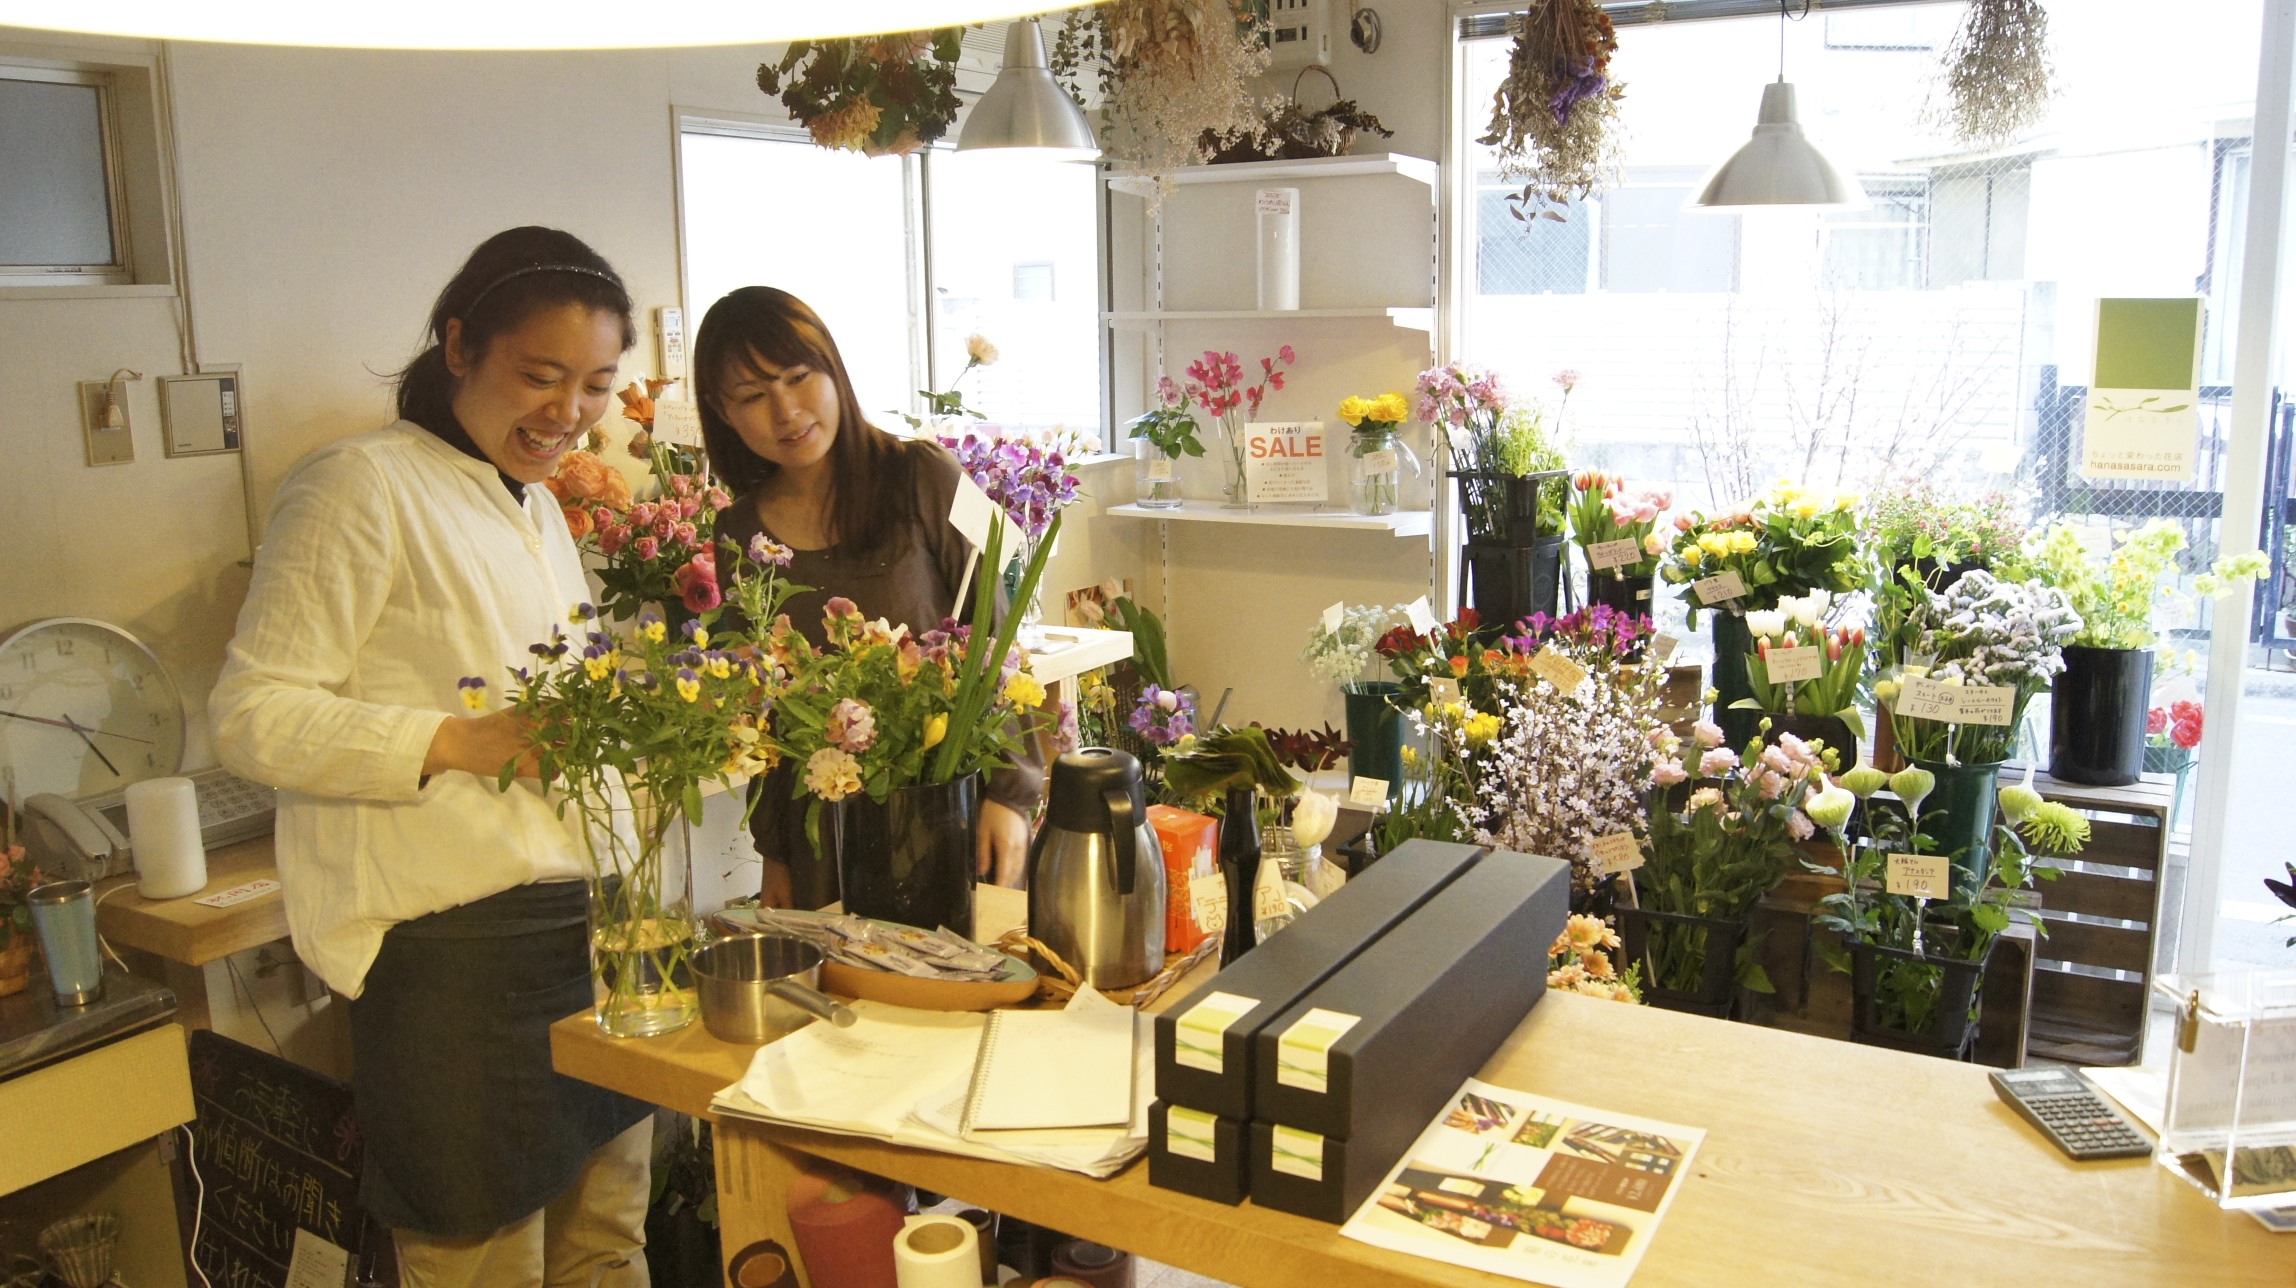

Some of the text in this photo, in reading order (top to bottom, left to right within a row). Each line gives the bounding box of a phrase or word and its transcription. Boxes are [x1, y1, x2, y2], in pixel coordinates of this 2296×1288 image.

[1269, 426, 1301, 435] わけあり
[1250, 436, 1323, 458] SALE
[2092, 450, 2183, 462] ちょっと変わった花店
[2090, 460, 2181, 472] hanasasara.com
[56, 639, 74, 656] 12
[214, 1184, 290, 1249] ください
